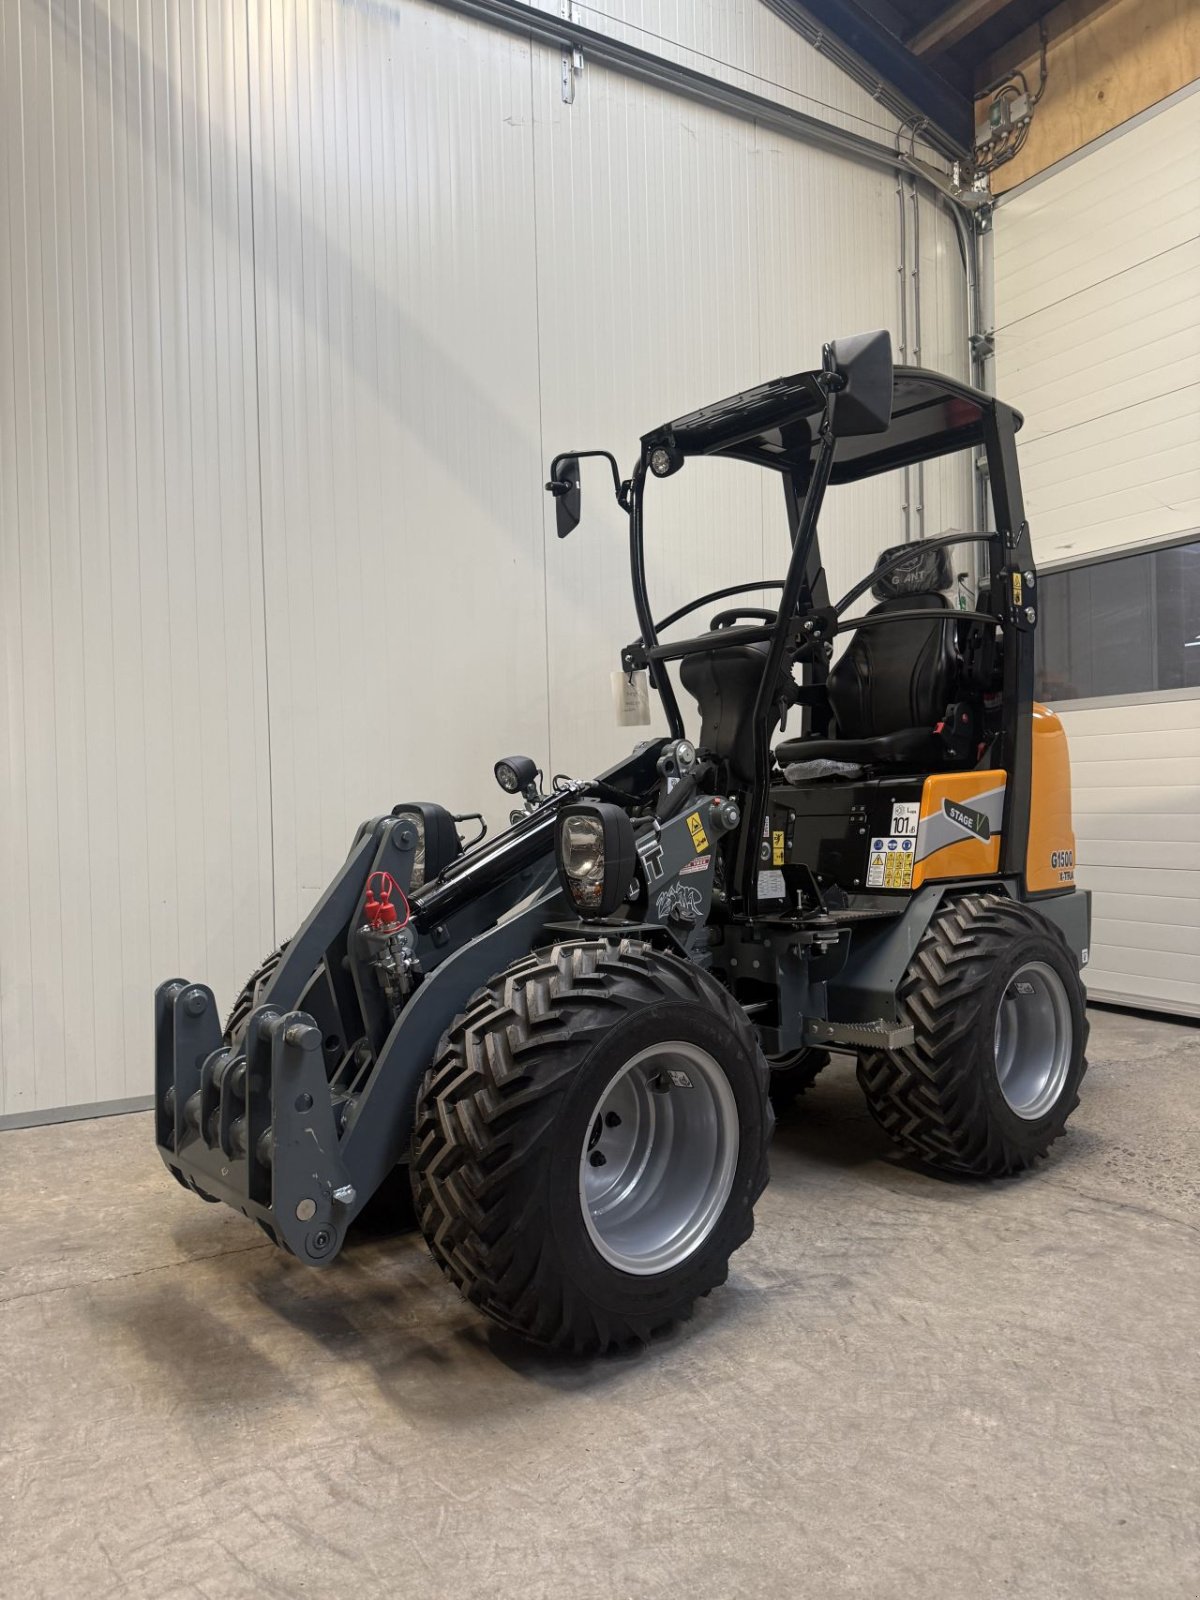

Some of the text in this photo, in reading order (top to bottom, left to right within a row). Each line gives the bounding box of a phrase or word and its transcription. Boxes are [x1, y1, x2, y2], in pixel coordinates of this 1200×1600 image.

[891, 570, 924, 585] GANT
[893, 817, 909, 834] 101
[949, 807, 974, 828] STAGE
